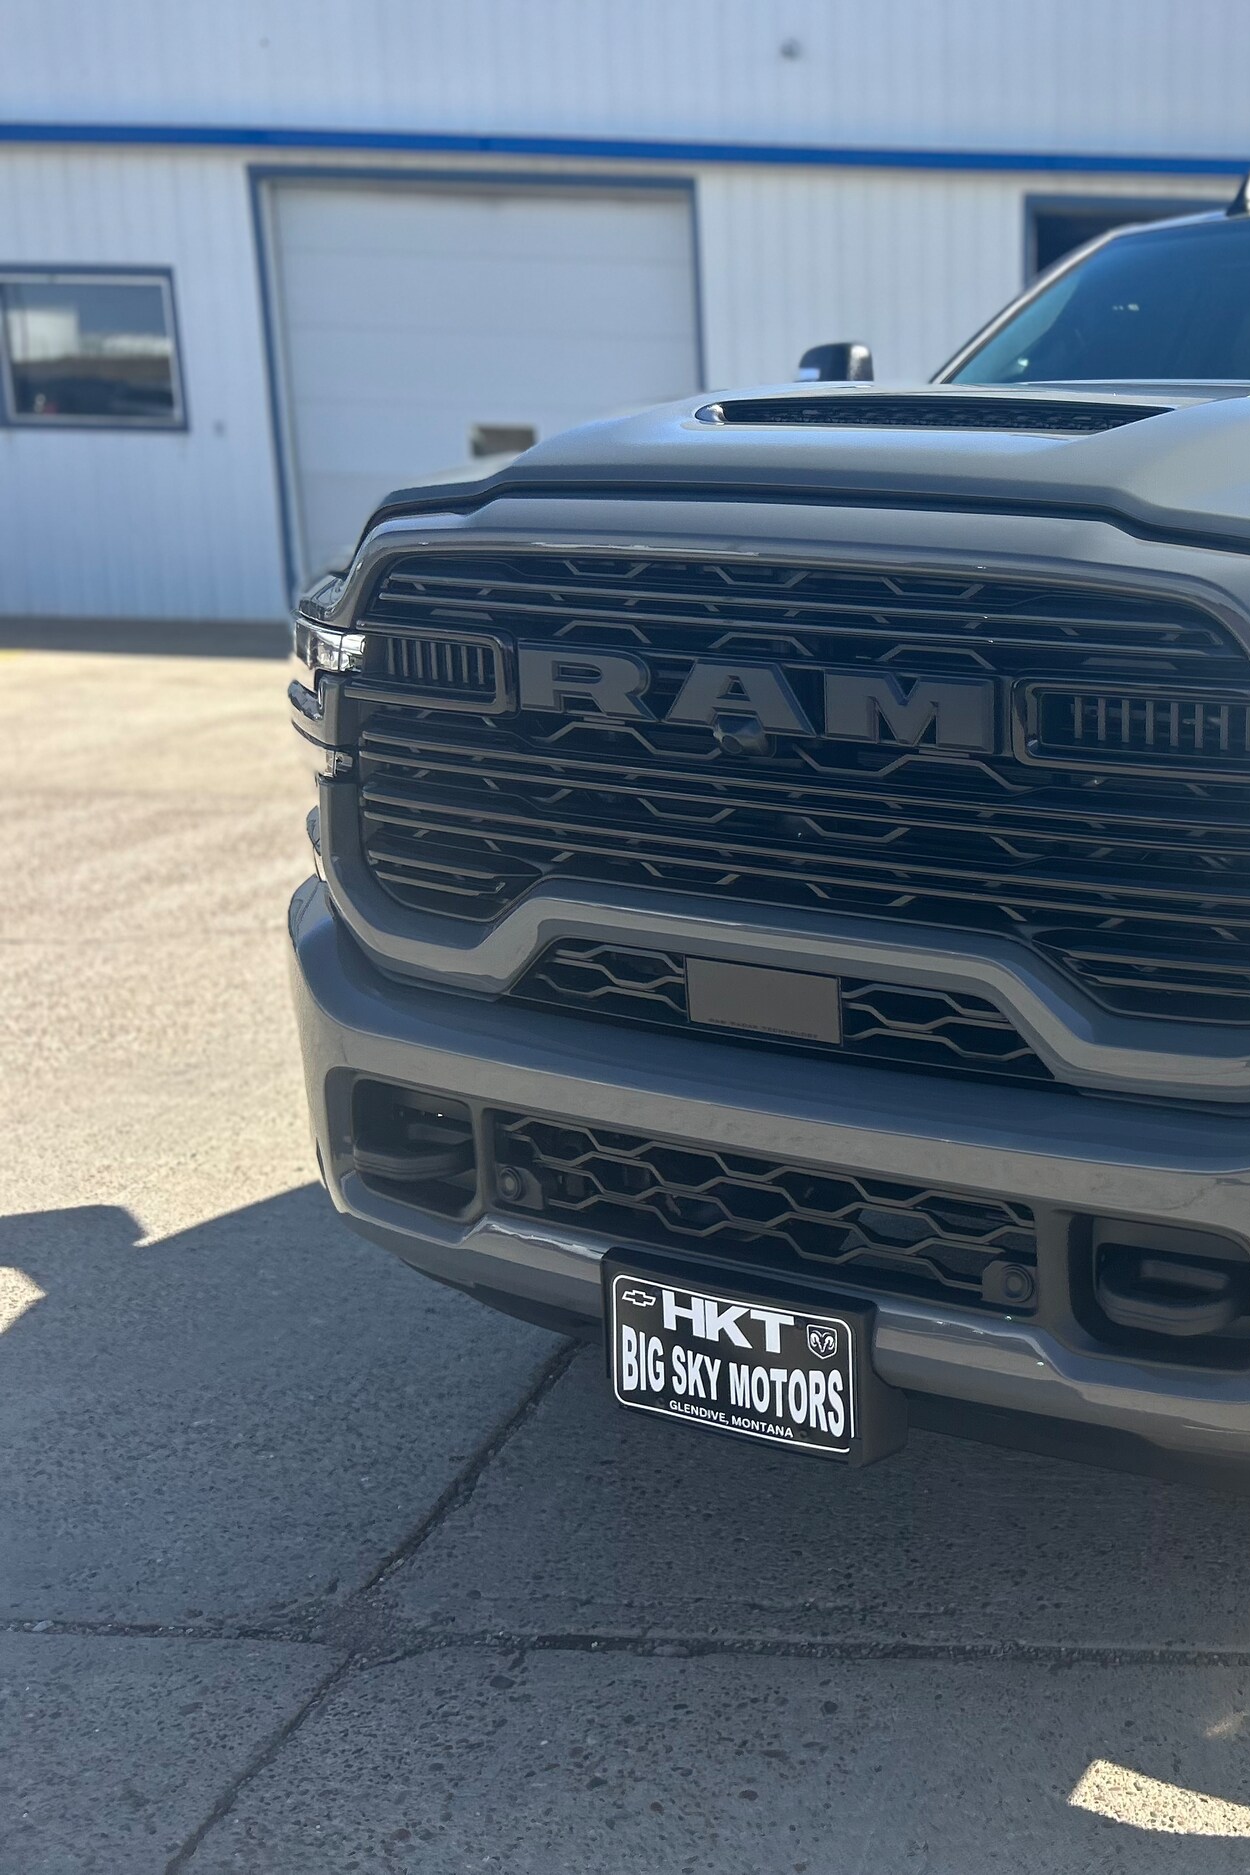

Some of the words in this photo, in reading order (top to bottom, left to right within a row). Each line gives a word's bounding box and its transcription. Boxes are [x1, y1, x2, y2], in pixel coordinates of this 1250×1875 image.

[517, 638, 994, 755] RAM
[661, 1289, 795, 1354] HKT
[621, 1323, 665, 1393] BIG
[671, 1345, 721, 1401] SKY
[729, 1361, 845, 1438] MOTORS
[669, 1399, 729, 1425] GLENDIVE,
[731, 1415, 794, 1438] MONTANA
